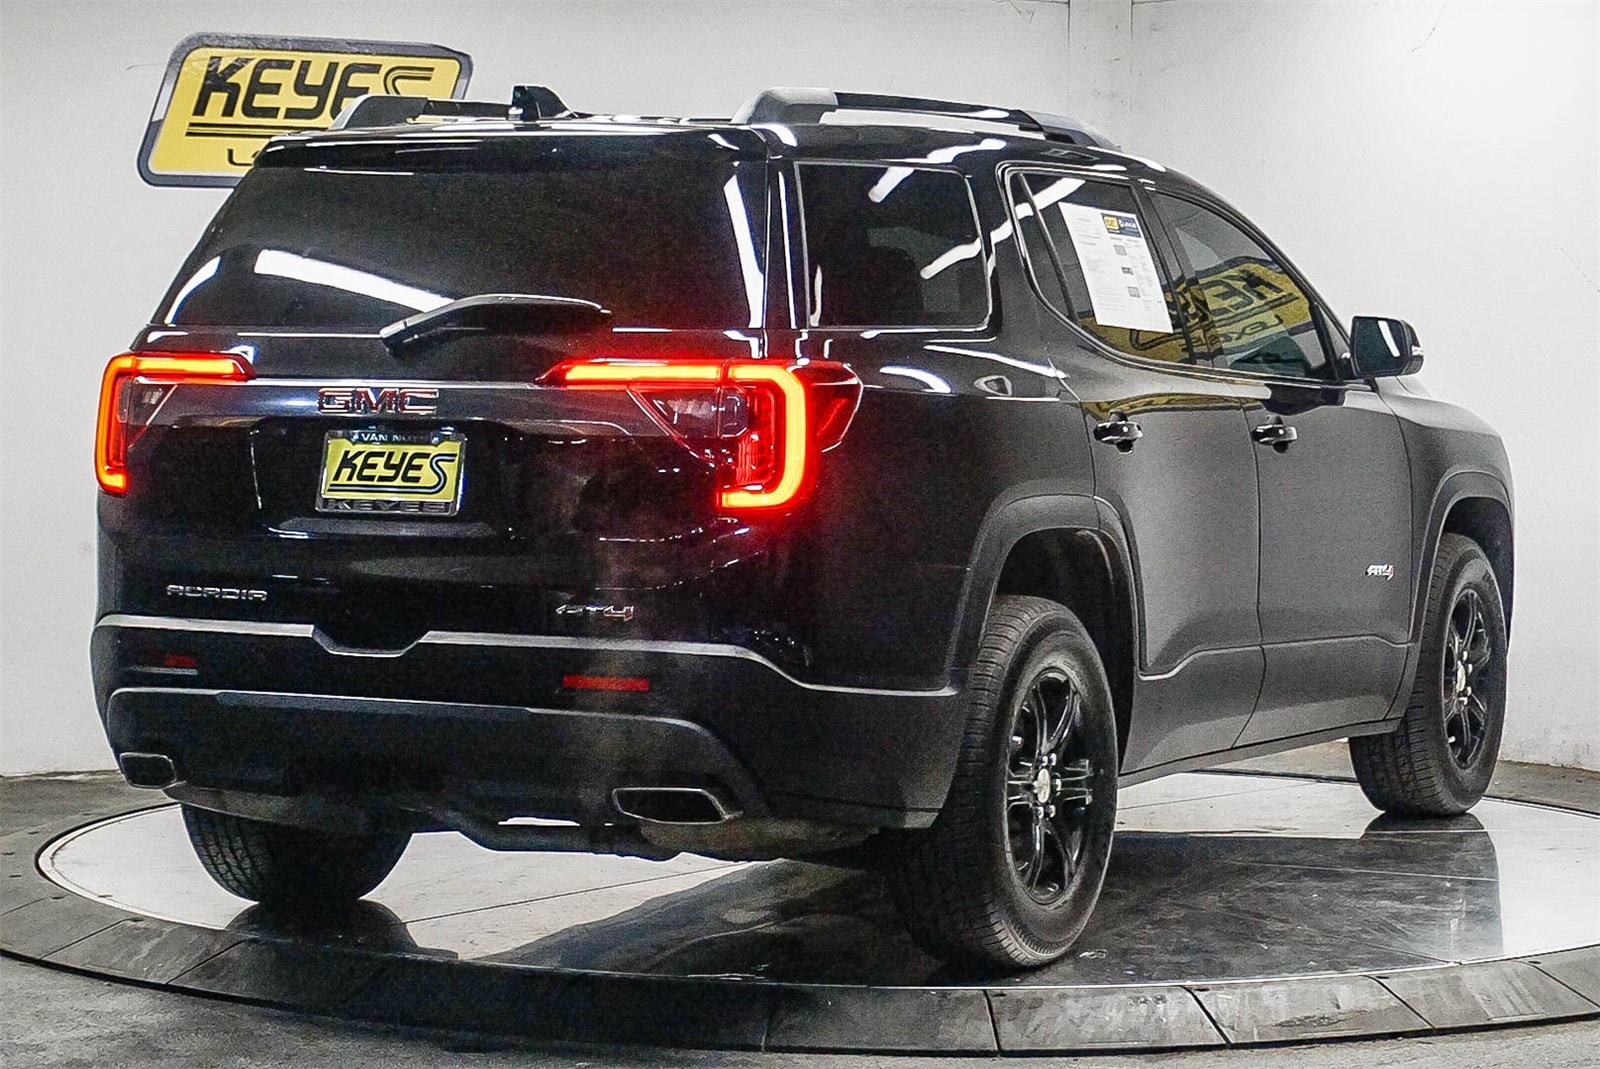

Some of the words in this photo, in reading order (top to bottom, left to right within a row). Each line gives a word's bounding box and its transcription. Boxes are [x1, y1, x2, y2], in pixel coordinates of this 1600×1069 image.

[318, 387, 439, 415] GMC
[361, 432, 388, 442] VAN
[331, 450, 457, 490] KEYES
[327, 499, 446, 512] KEYES
[166, 584, 268, 601] ACADIA
